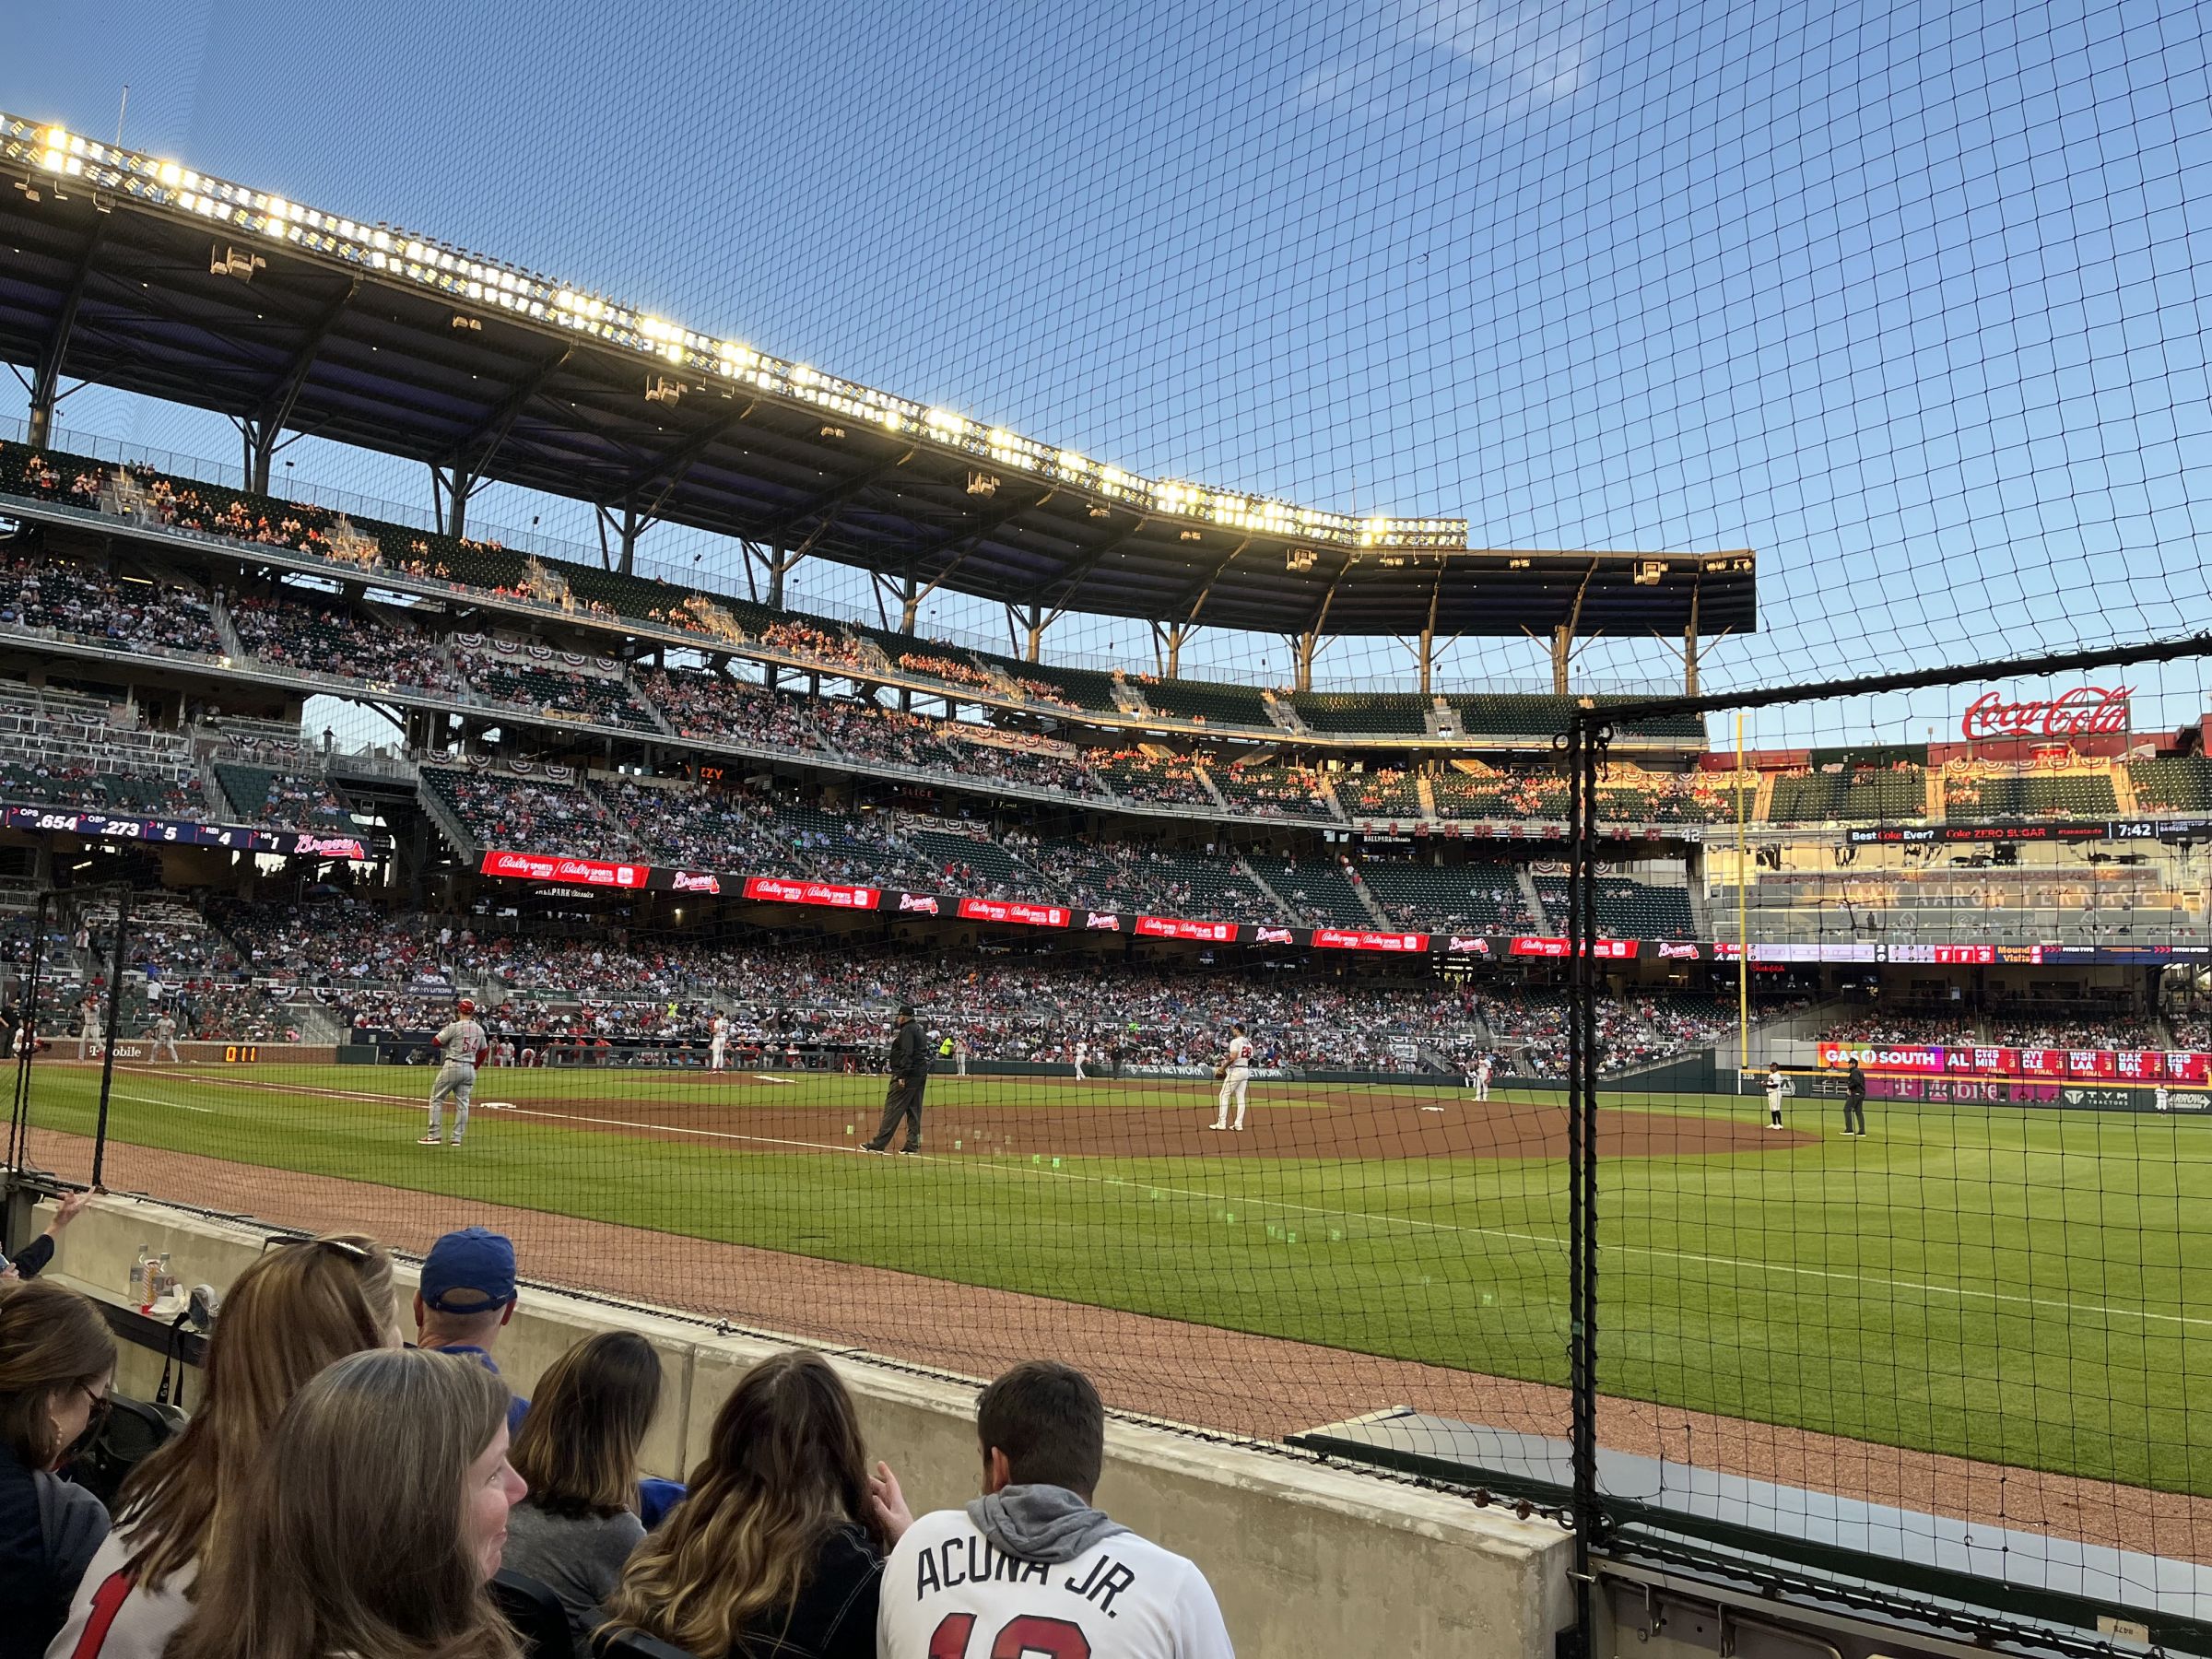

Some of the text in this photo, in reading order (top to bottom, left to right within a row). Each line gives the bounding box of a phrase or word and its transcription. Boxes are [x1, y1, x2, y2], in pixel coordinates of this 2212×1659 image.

[1961, 685, 2138, 740] Coca-Cola
[20, 808, 39, 818] OPS
[35, 814, 77, 830] .654
[88, 816, 107, 824] OBP
[100, 820, 140, 837] .273
[164, 827, 177, 841] 5
[1611, 827, 1630, 841] 44
[1946, 830, 1971, 839] Coke
[1974, 830, 2004, 839] ZERO
[2119, 825, 2151, 837] 7:42
[218, 831, 231, 845] 4
[1681, 830, 1700, 842] 42
[1852, 830, 1935, 841] Best Coke Ever?
[271, 837, 280, 850] 1
[294, 834, 354, 853] Braves
[499, 855, 553, 873] Bally SPORTS
[560, 862, 591, 878] Bally
[672, 871, 714, 889] Braves
[757, 881, 782, 896] Bally
[807, 886, 831, 900] Bally
[1837, 884, 2155, 907] HANK AARON TERRACE
[968, 901, 990, 914] Bally
[1010, 906, 1031, 918] Bally
[1145, 919, 1162, 933] Bally
[1181, 923, 1198, 934] Bally
[1322, 932, 1343, 944] Bally
[1363, 935, 1383, 947] Bally
[1521, 939, 1545, 951] Bally
[1997, 946, 2030, 954] Mound
[1941, 951, 1948, 961] 1
[1960, 951, 1969, 961] 1
[2003, 954, 2030, 962] Visits
[463, 1036, 478, 1052] 54
[89, 1046, 142, 1057] T-obile
[1975, 1049, 1999, 1058] CWS
[2021, 1051, 2044, 1059] NYY
[2069, 1052, 2096, 1061] WSH
[1826, 1051, 1936, 1065] GAS SOUTH
[1947, 1053, 1971, 1066] AL
[1975, 1058, 1997, 1066] MIN
[2022, 1060, 2043, 1068] CLE
[2118, 1053, 2142, 1063] OAK
[2167, 1053, 2192, 1064] BOS
[1141, 1065, 1205, 1077] MLB NETWORK
[1249, 1067, 1283, 1077] ETWORK
[2070, 1061, 2112, 1071] LAA 3
[2118, 1063, 2161, 1072] BAL 2
[2167, 1064, 2183, 1073] TB
[2086, 1091, 2128, 1100] TYM
[1065, 1555, 1136, 1619] JR.
